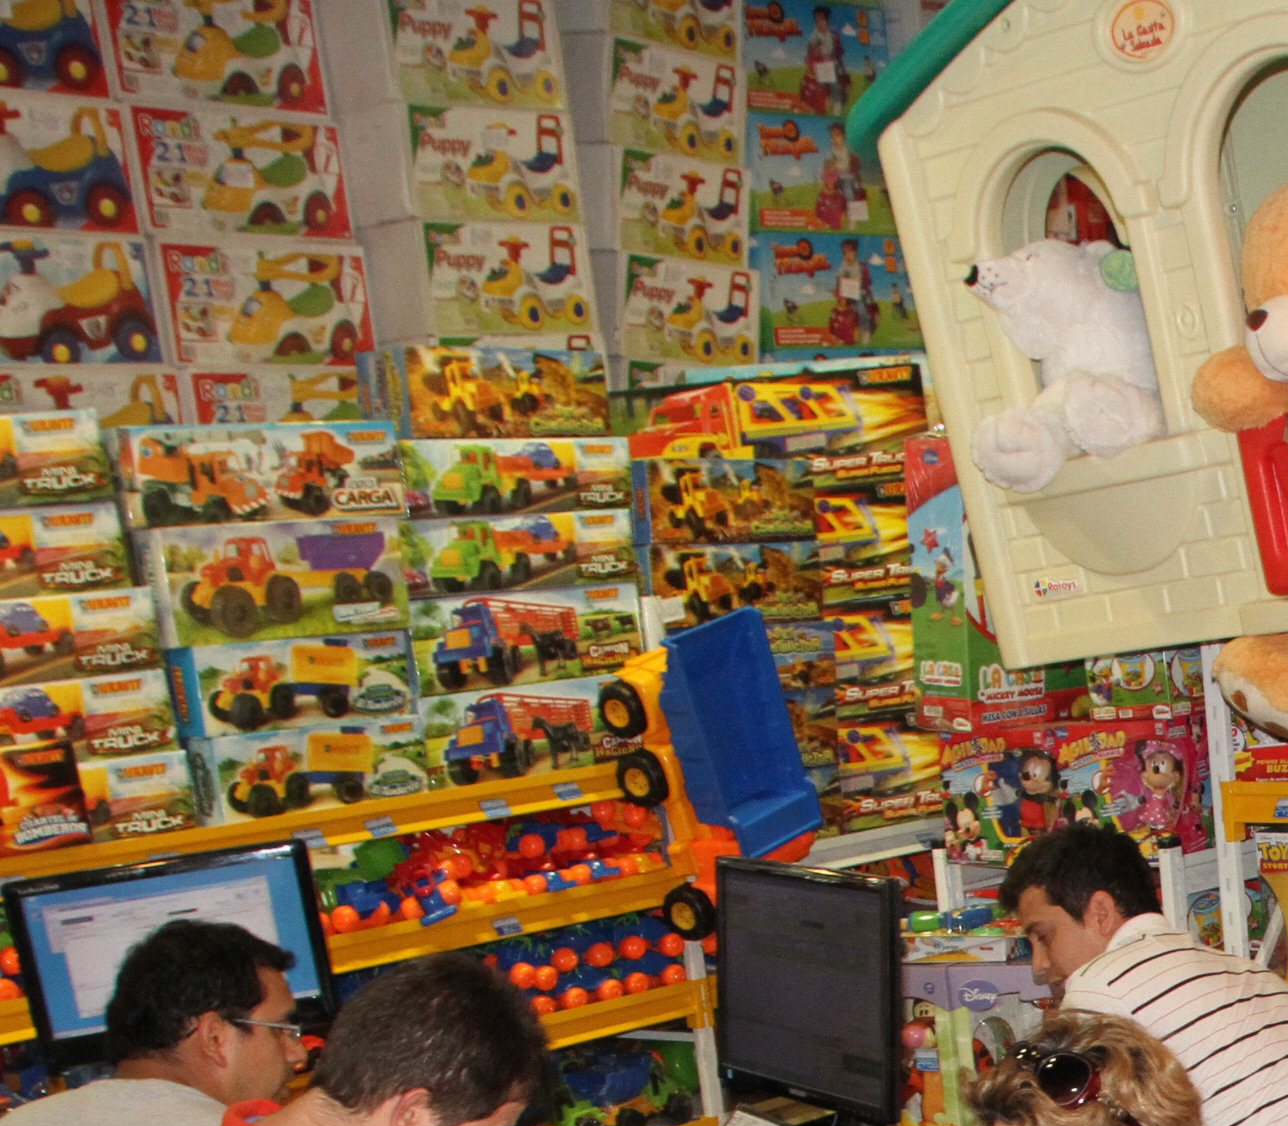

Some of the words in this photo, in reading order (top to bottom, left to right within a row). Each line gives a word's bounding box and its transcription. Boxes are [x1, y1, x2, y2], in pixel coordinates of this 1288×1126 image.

[399, 12, 452, 40] Puppy
[420, 130, 472, 157] Puppy
[434, 246, 486, 272] Puppy
[868, 451, 906, 465] TRUC
[23, 473, 96, 490] TRUCK
[334, 487, 395, 508] CARGA
[579, 491, 624, 503] TRUCK
[580, 561, 627, 573] TRUCK
[41, 568, 113, 585] TRUCK
[79, 650, 149, 666] TRUCK
[90, 733, 161, 750] TRUCK
[917, 790, 942, 805] TRU
[115, 816, 184, 833] TRUCK
